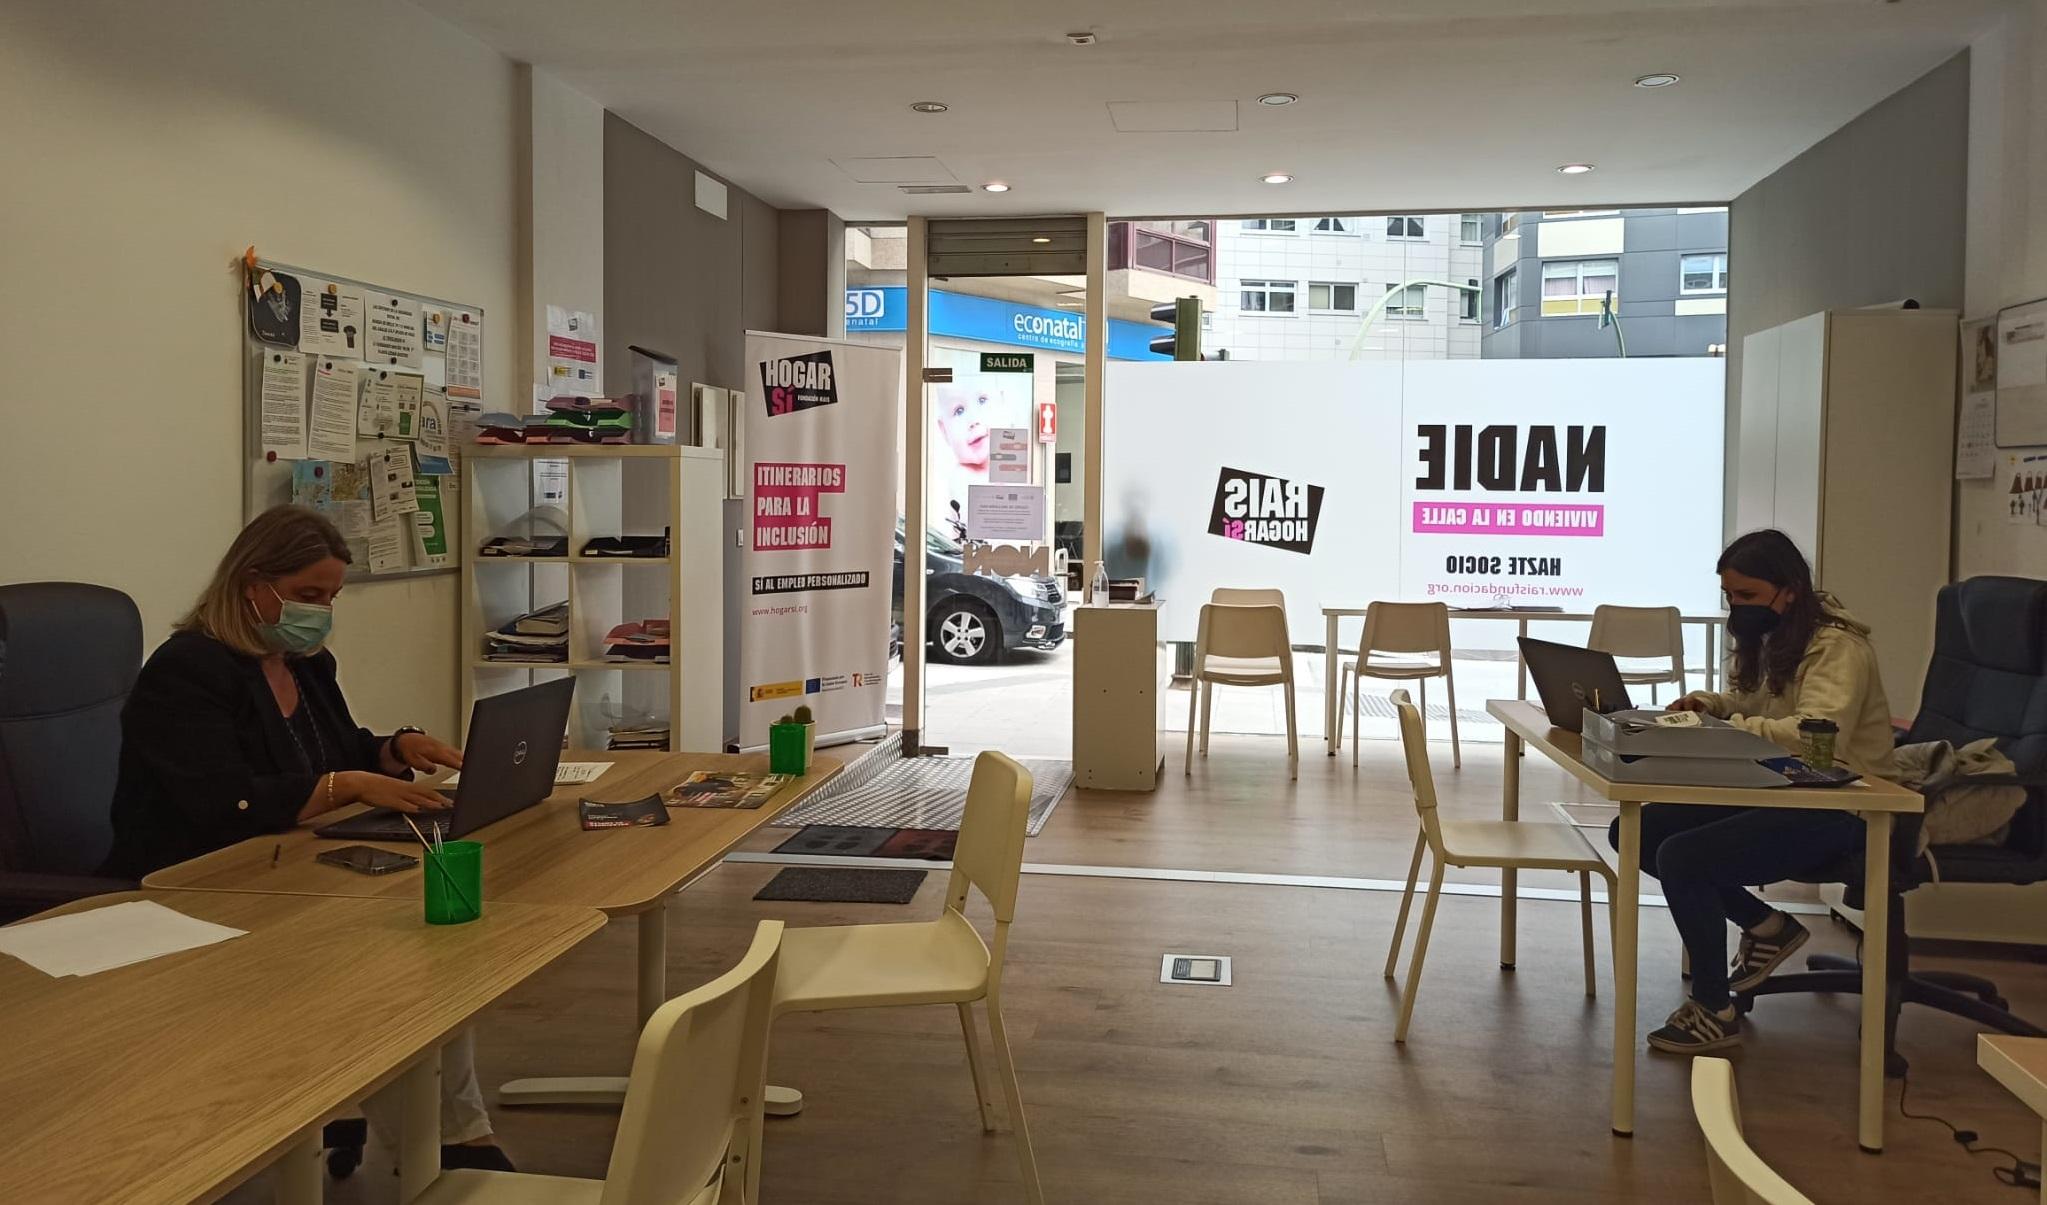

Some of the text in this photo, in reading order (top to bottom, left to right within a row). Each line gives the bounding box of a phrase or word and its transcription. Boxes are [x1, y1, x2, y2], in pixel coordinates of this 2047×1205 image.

[846, 292, 881, 316] 5D
[1014, 313, 1083, 341] econatal
[1017, 333, 1039, 342] centro
[1040, 335, 1049, 343] de
[986, 357, 1028, 369] SALIDA
[765, 360, 832, 391] HOGAR
[757, 466, 841, 487] ITINERARIOS
[757, 496, 811, 516] PARA LA
[756, 521, 829, 547] INCLUSIÓN
[765, 578, 775, 591] AL
[777, 576, 806, 590] EMPLEO
[807, 573, 867, 588] PERSONALIZADO
[752, 604, 808, 617] www.hogarsi.org
